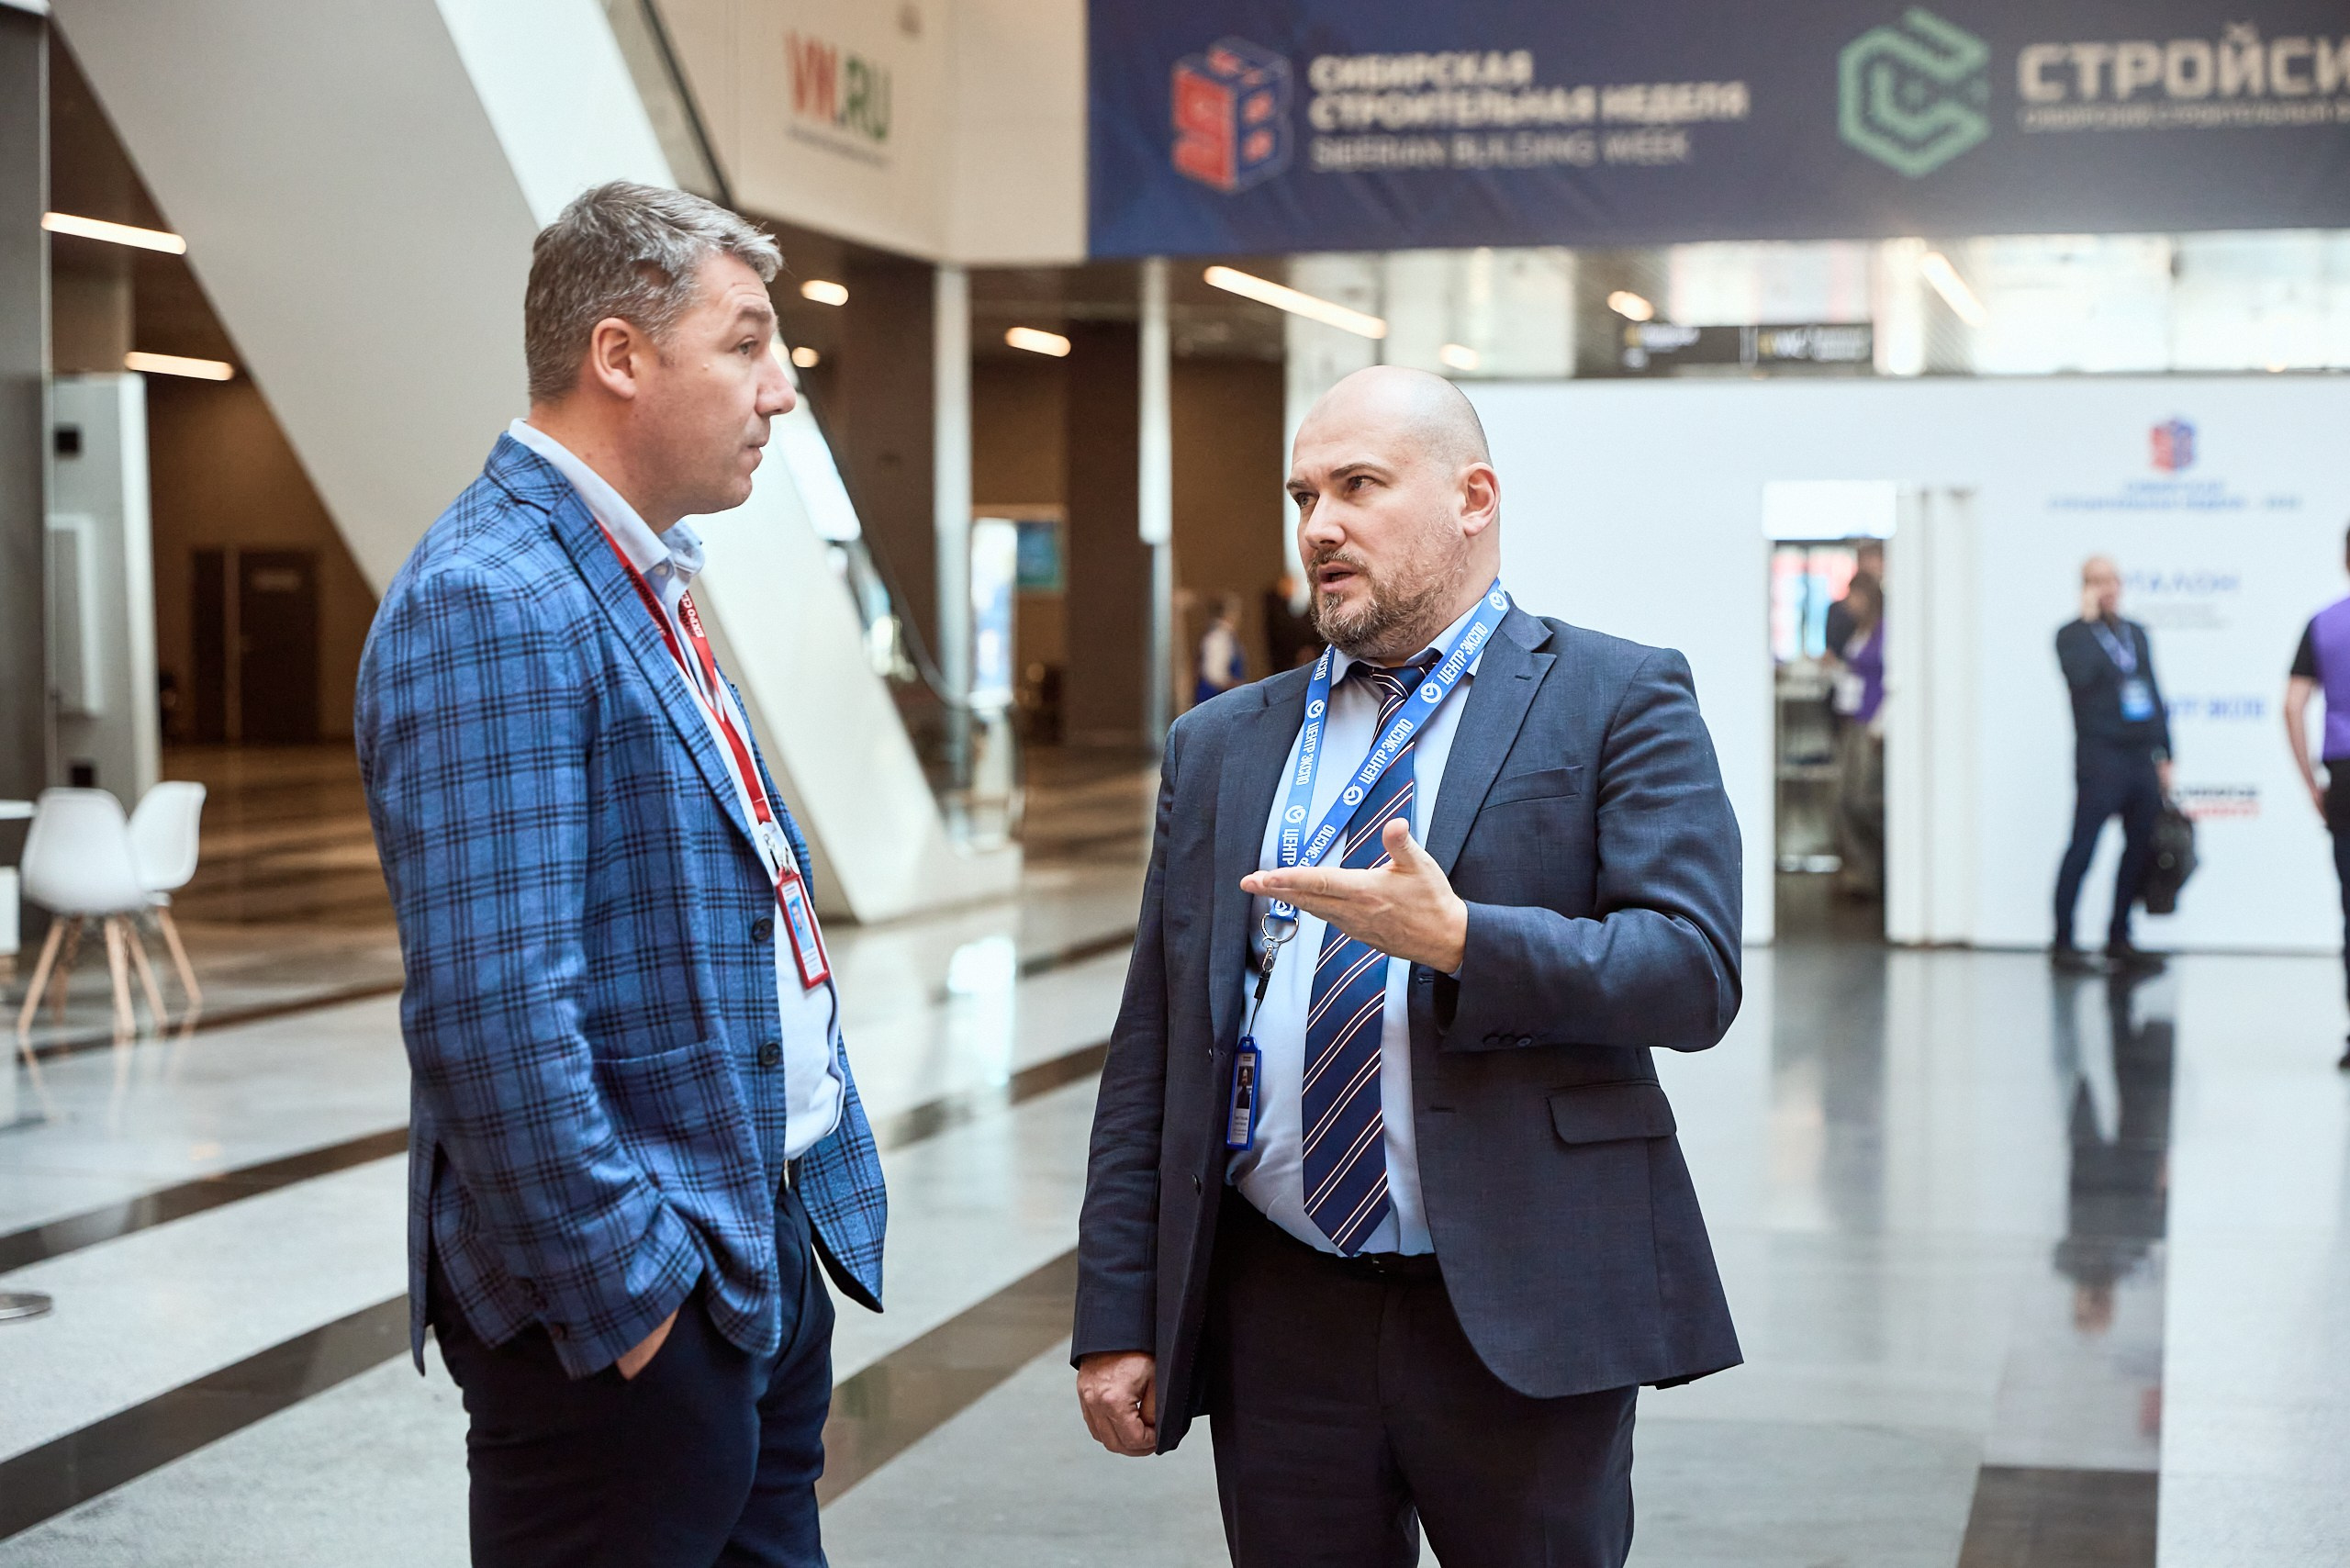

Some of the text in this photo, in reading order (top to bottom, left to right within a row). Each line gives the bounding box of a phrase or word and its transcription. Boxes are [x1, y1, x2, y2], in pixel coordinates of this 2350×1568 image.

[1309, 50, 1533, 91] СИБИРСКАЯ
[1309, 85, 1595, 130] СТРОИТЕЛЬНАЯ
[1436, 621, 1488, 686] ЦЕНТР ЭКСПО
[1295, 721, 1320, 786] ЦЕНТР ЭКСПО
[1358, 718, 1414, 785] ЦЕНТР ЭКСПО
[1281, 828, 1300, 866] ЦЕНТР
[1304, 823, 1337, 859] ЭКСПО
